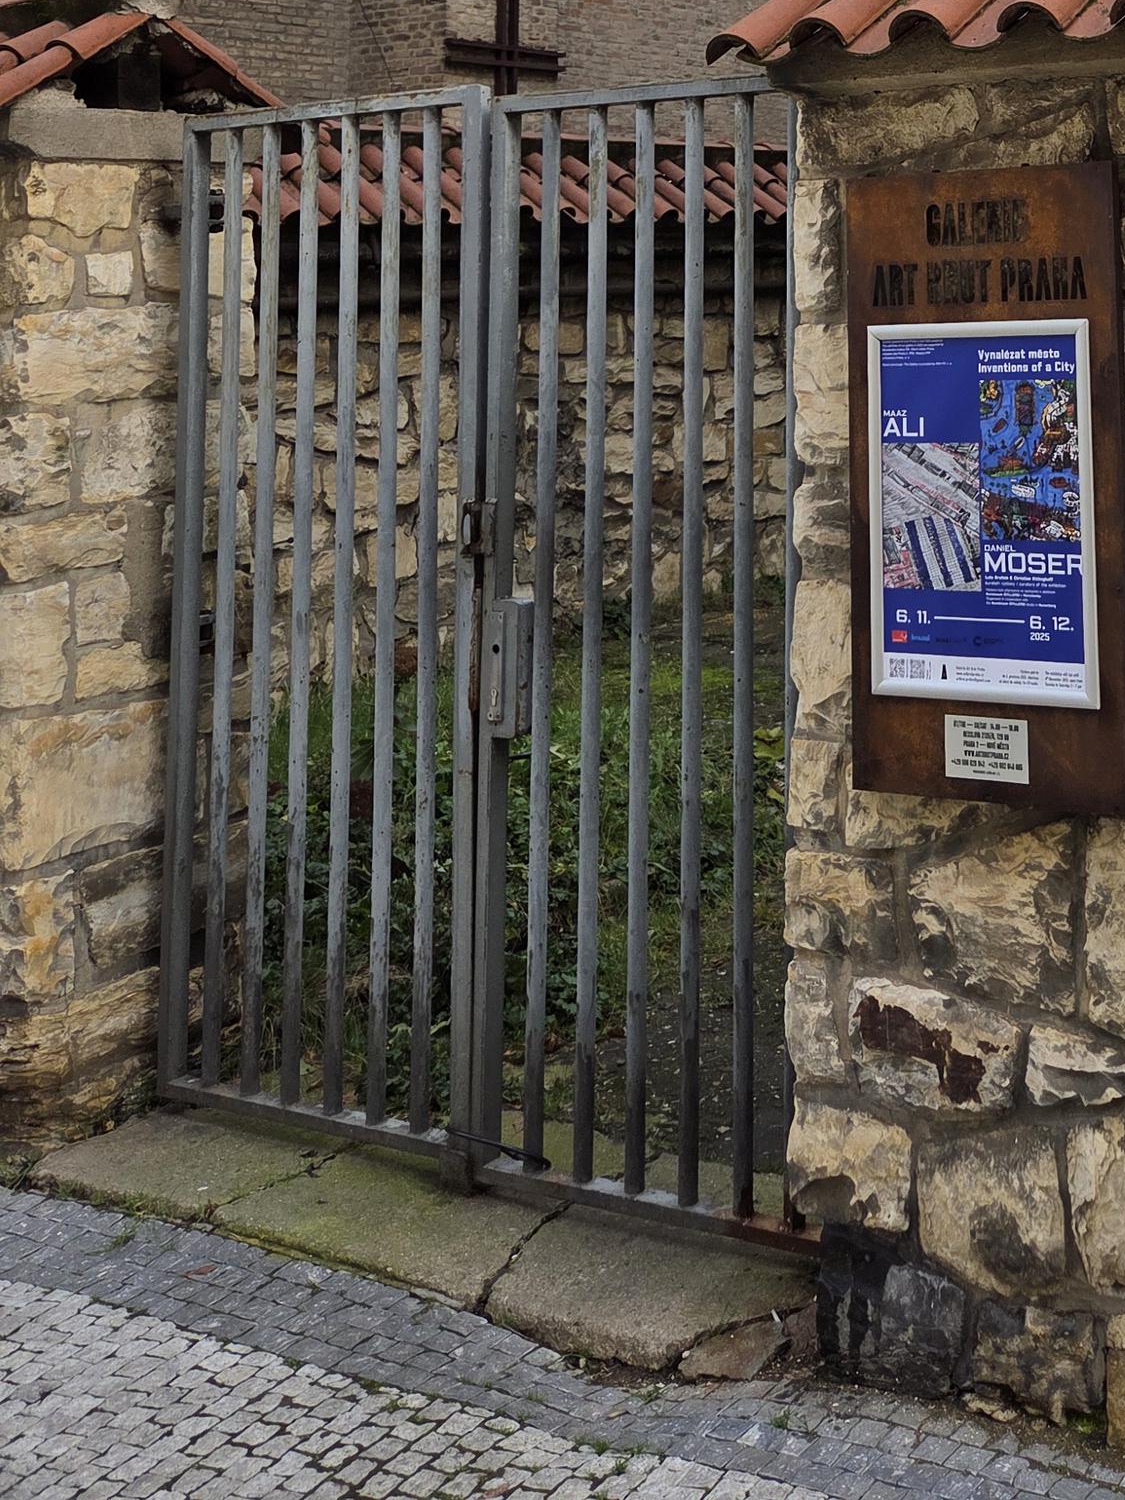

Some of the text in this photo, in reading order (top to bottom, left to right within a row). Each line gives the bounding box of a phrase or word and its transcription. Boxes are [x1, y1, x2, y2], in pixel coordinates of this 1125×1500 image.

[925, 199, 1026, 247] GALERIE
[872, 256, 1088, 307] ART BRUT PRAHA
[978, 361, 1075, 374] Inventions of a City
[883, 409, 907, 417] MAAZ
[883, 417, 924, 438] ALI
[984, 544, 1017, 553] DANIEL
[984, 552, 1083, 576] MOSER
[896, 609, 931, 625] 6. 11.
[1029, 615, 1074, 632] 6. 12.
[1030, 632, 1051, 642] 2025
